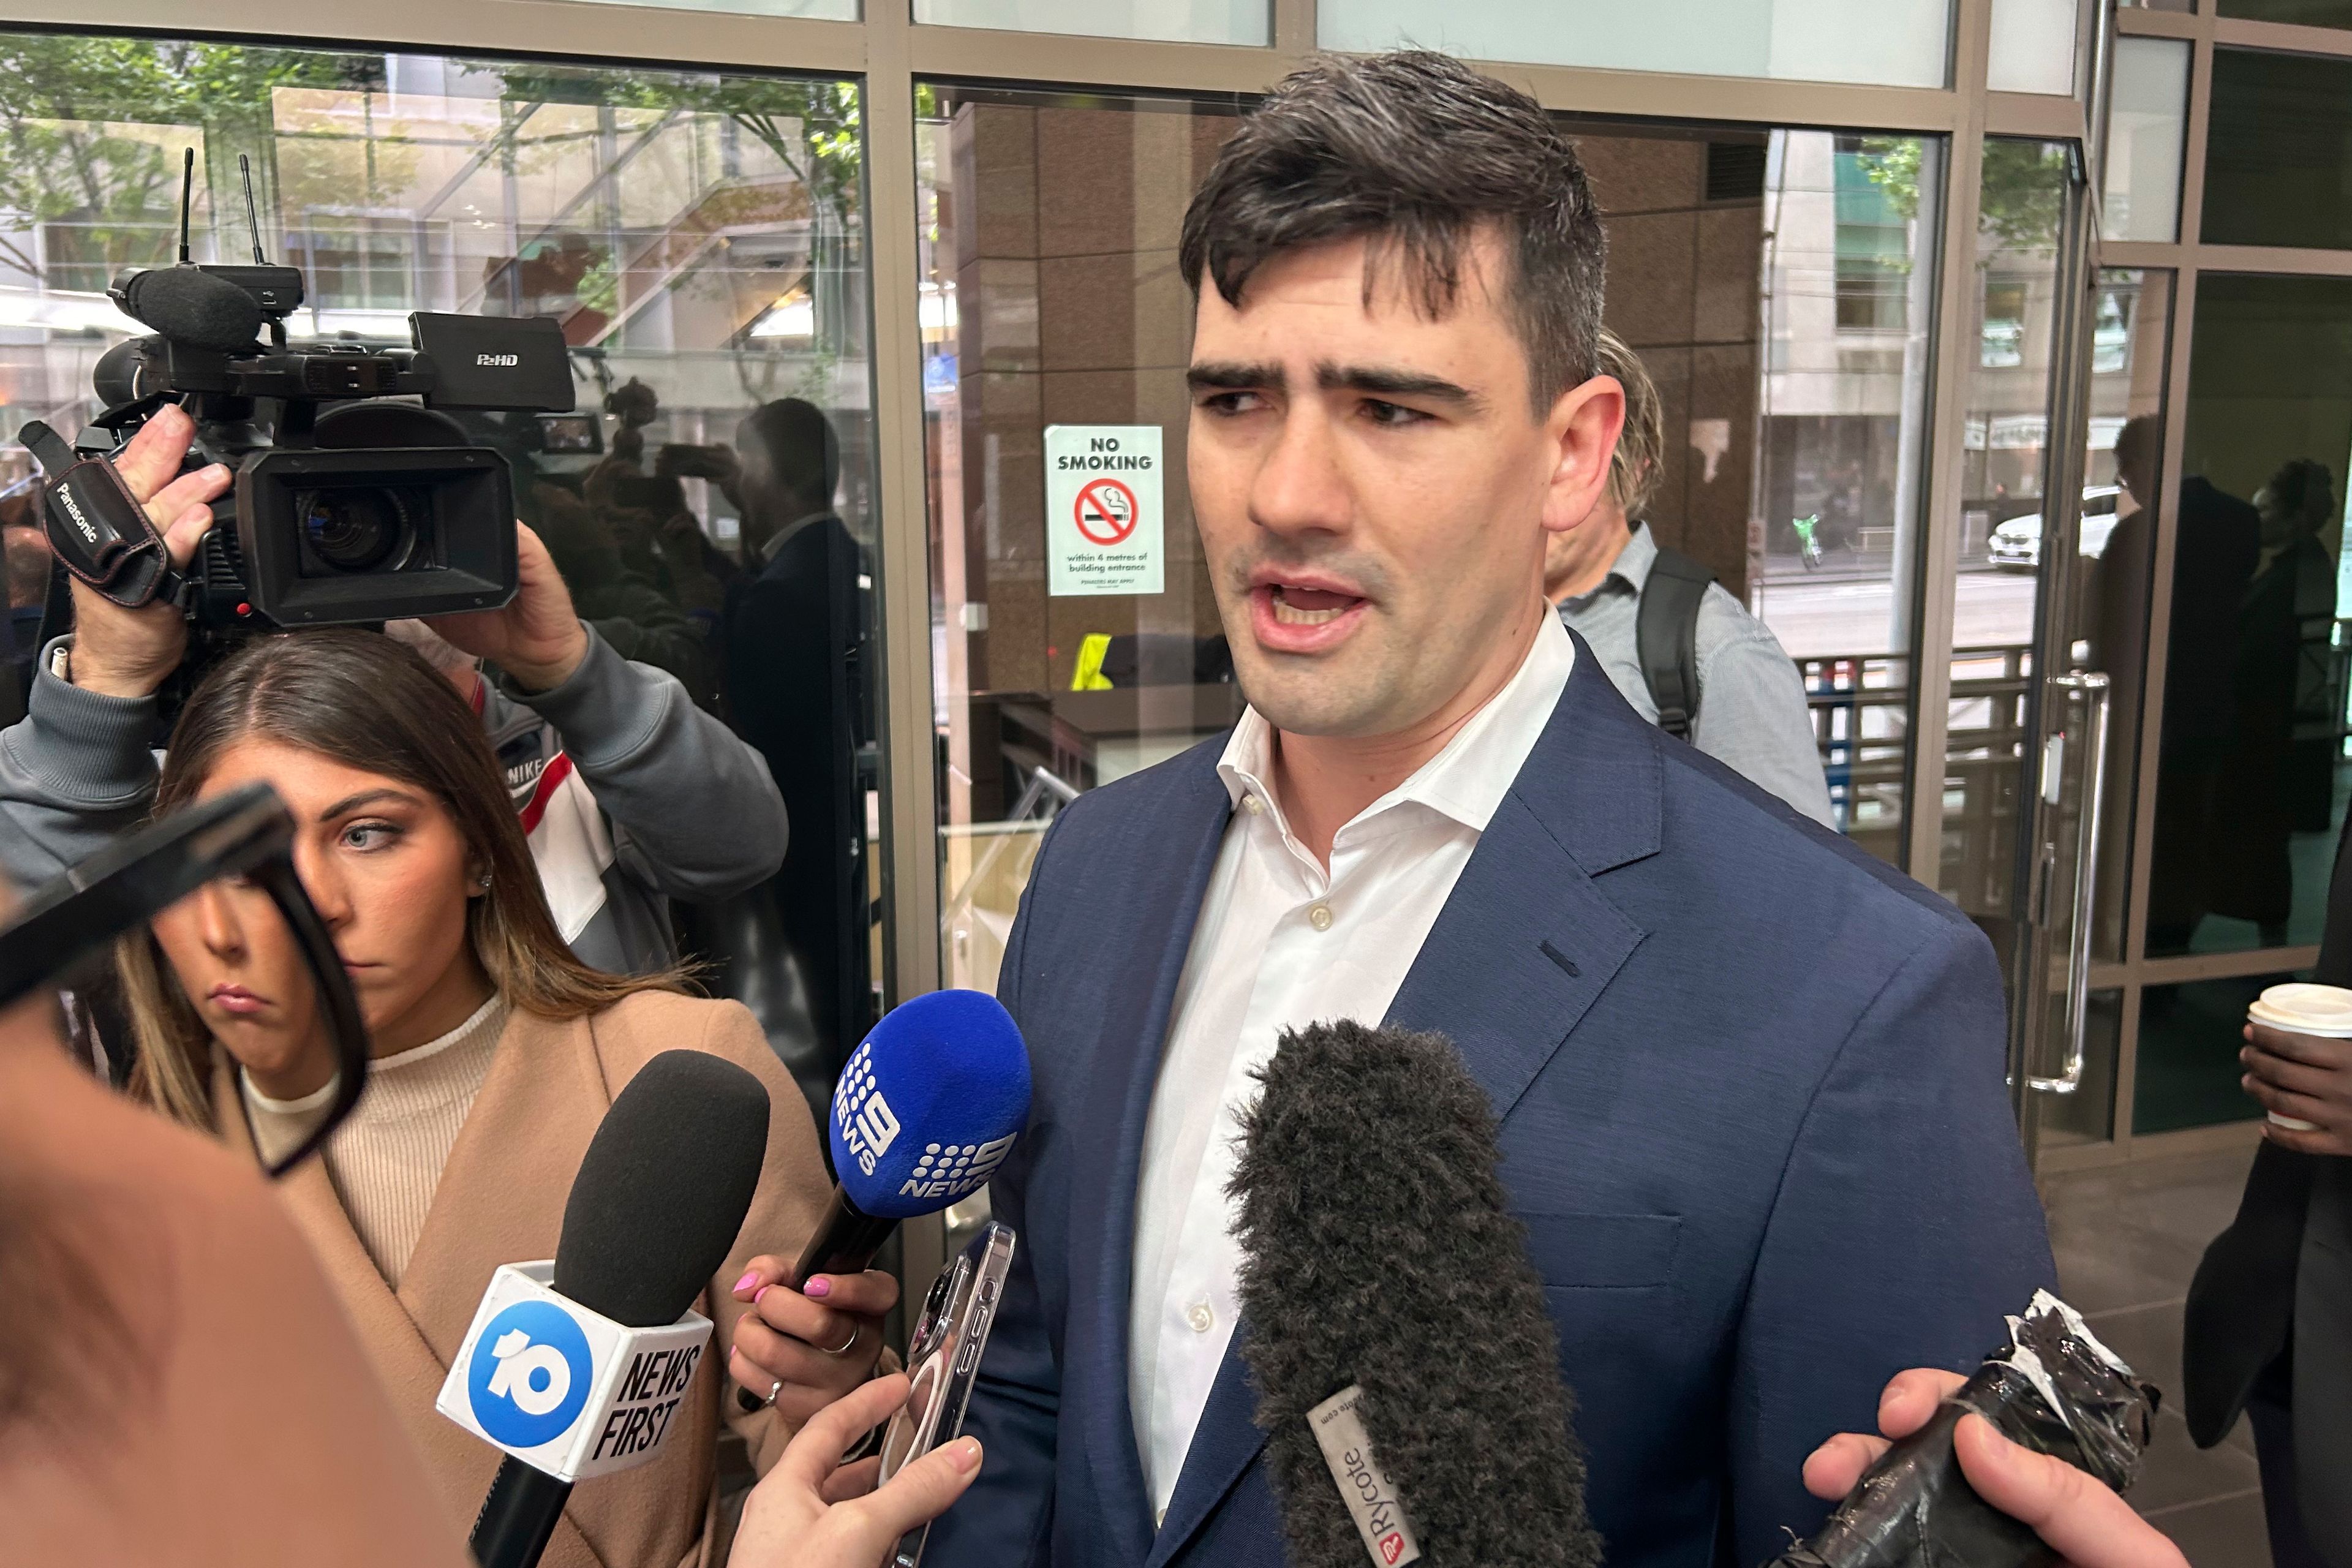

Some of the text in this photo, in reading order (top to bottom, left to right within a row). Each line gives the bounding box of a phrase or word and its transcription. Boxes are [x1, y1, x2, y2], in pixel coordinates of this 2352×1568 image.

[477, 354, 518, 366] P2HD
[1091, 438, 1120, 452] NO
[1058, 456, 1153, 470] SMOKING
[56, 482, 97, 543] Panasonic
[1067, 553, 1095, 562] within
[1138, 552, 1148, 561] of
[1069, 564, 1105, 573] building
[507, 759, 543, 784] NIKE
[836, 1074, 876, 1176] NEWS
[899, 1168, 995, 1197] NEWS
[488, 1328, 571, 1415] 10
[617, 1344, 701, 1402] NEWS
[592, 1398, 681, 1460] FIRST
[1344, 1448, 1395, 1537] Rycote
